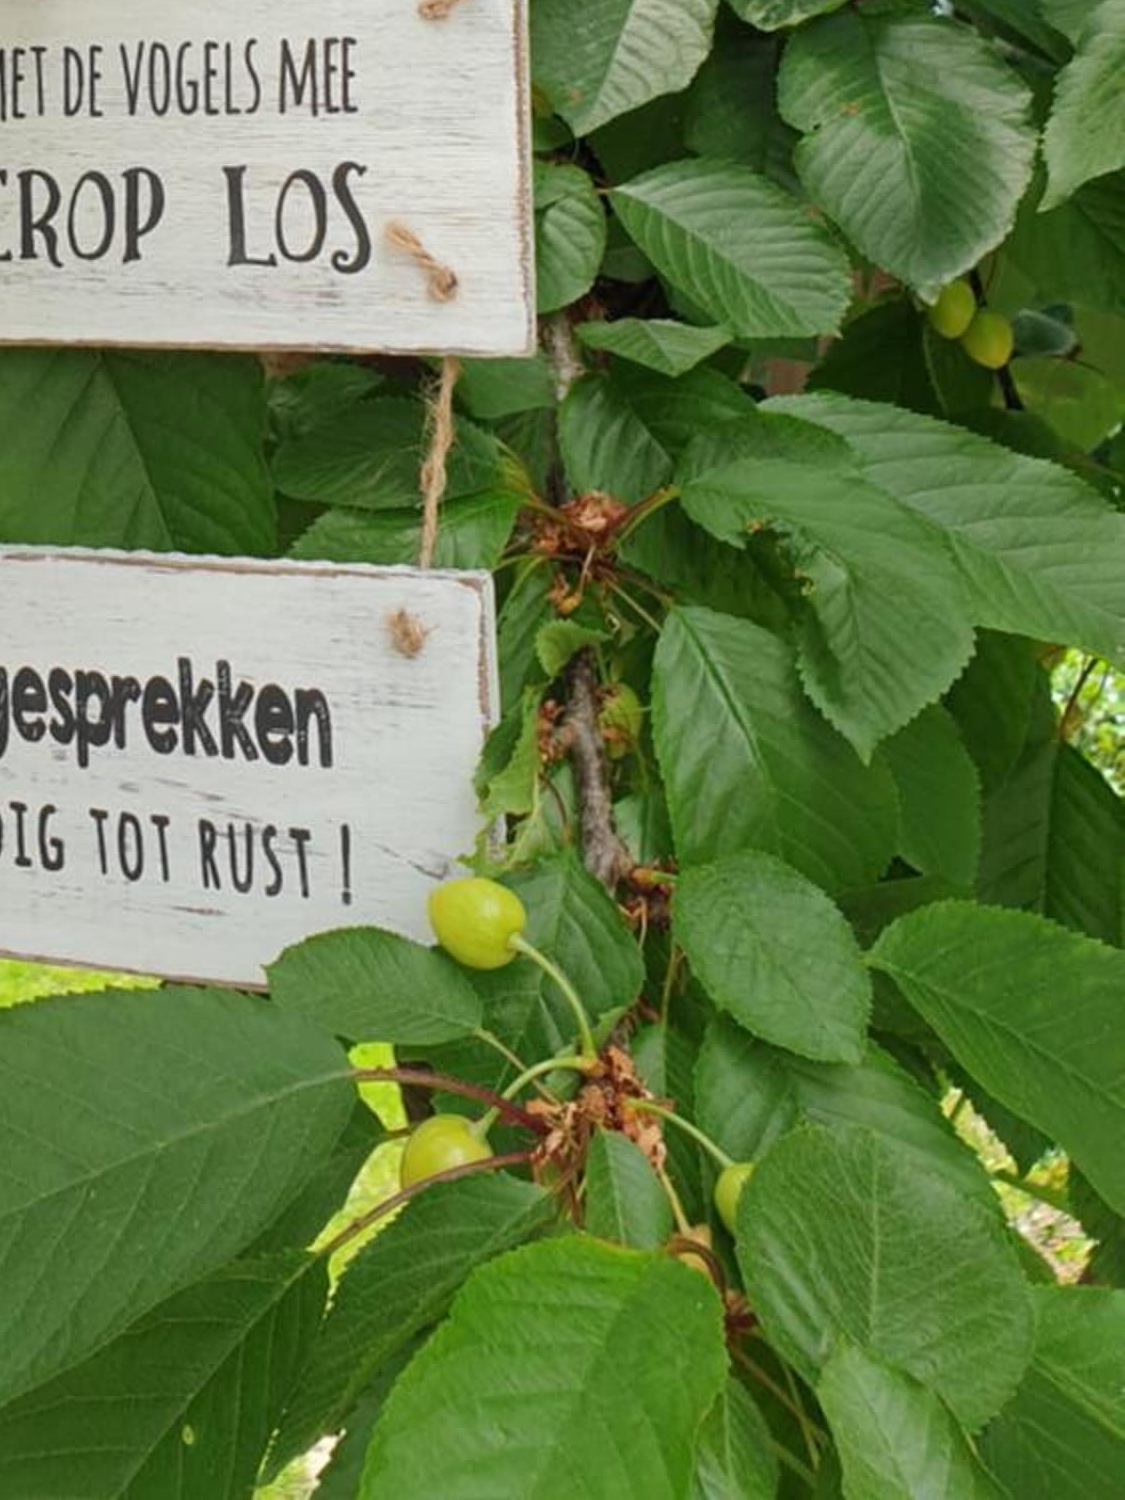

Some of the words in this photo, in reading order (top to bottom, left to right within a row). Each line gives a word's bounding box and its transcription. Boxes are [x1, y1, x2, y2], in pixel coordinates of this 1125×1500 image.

[62, 45, 104, 118] DE
[119, 38, 262, 117] VOGELS
[278, 36, 360, 117] MEE
[221, 160, 373, 275] LOS
[88, 807, 171, 883] TOT
[197, 817, 312, 900] RUST
[339, 823, 353, 906] !
